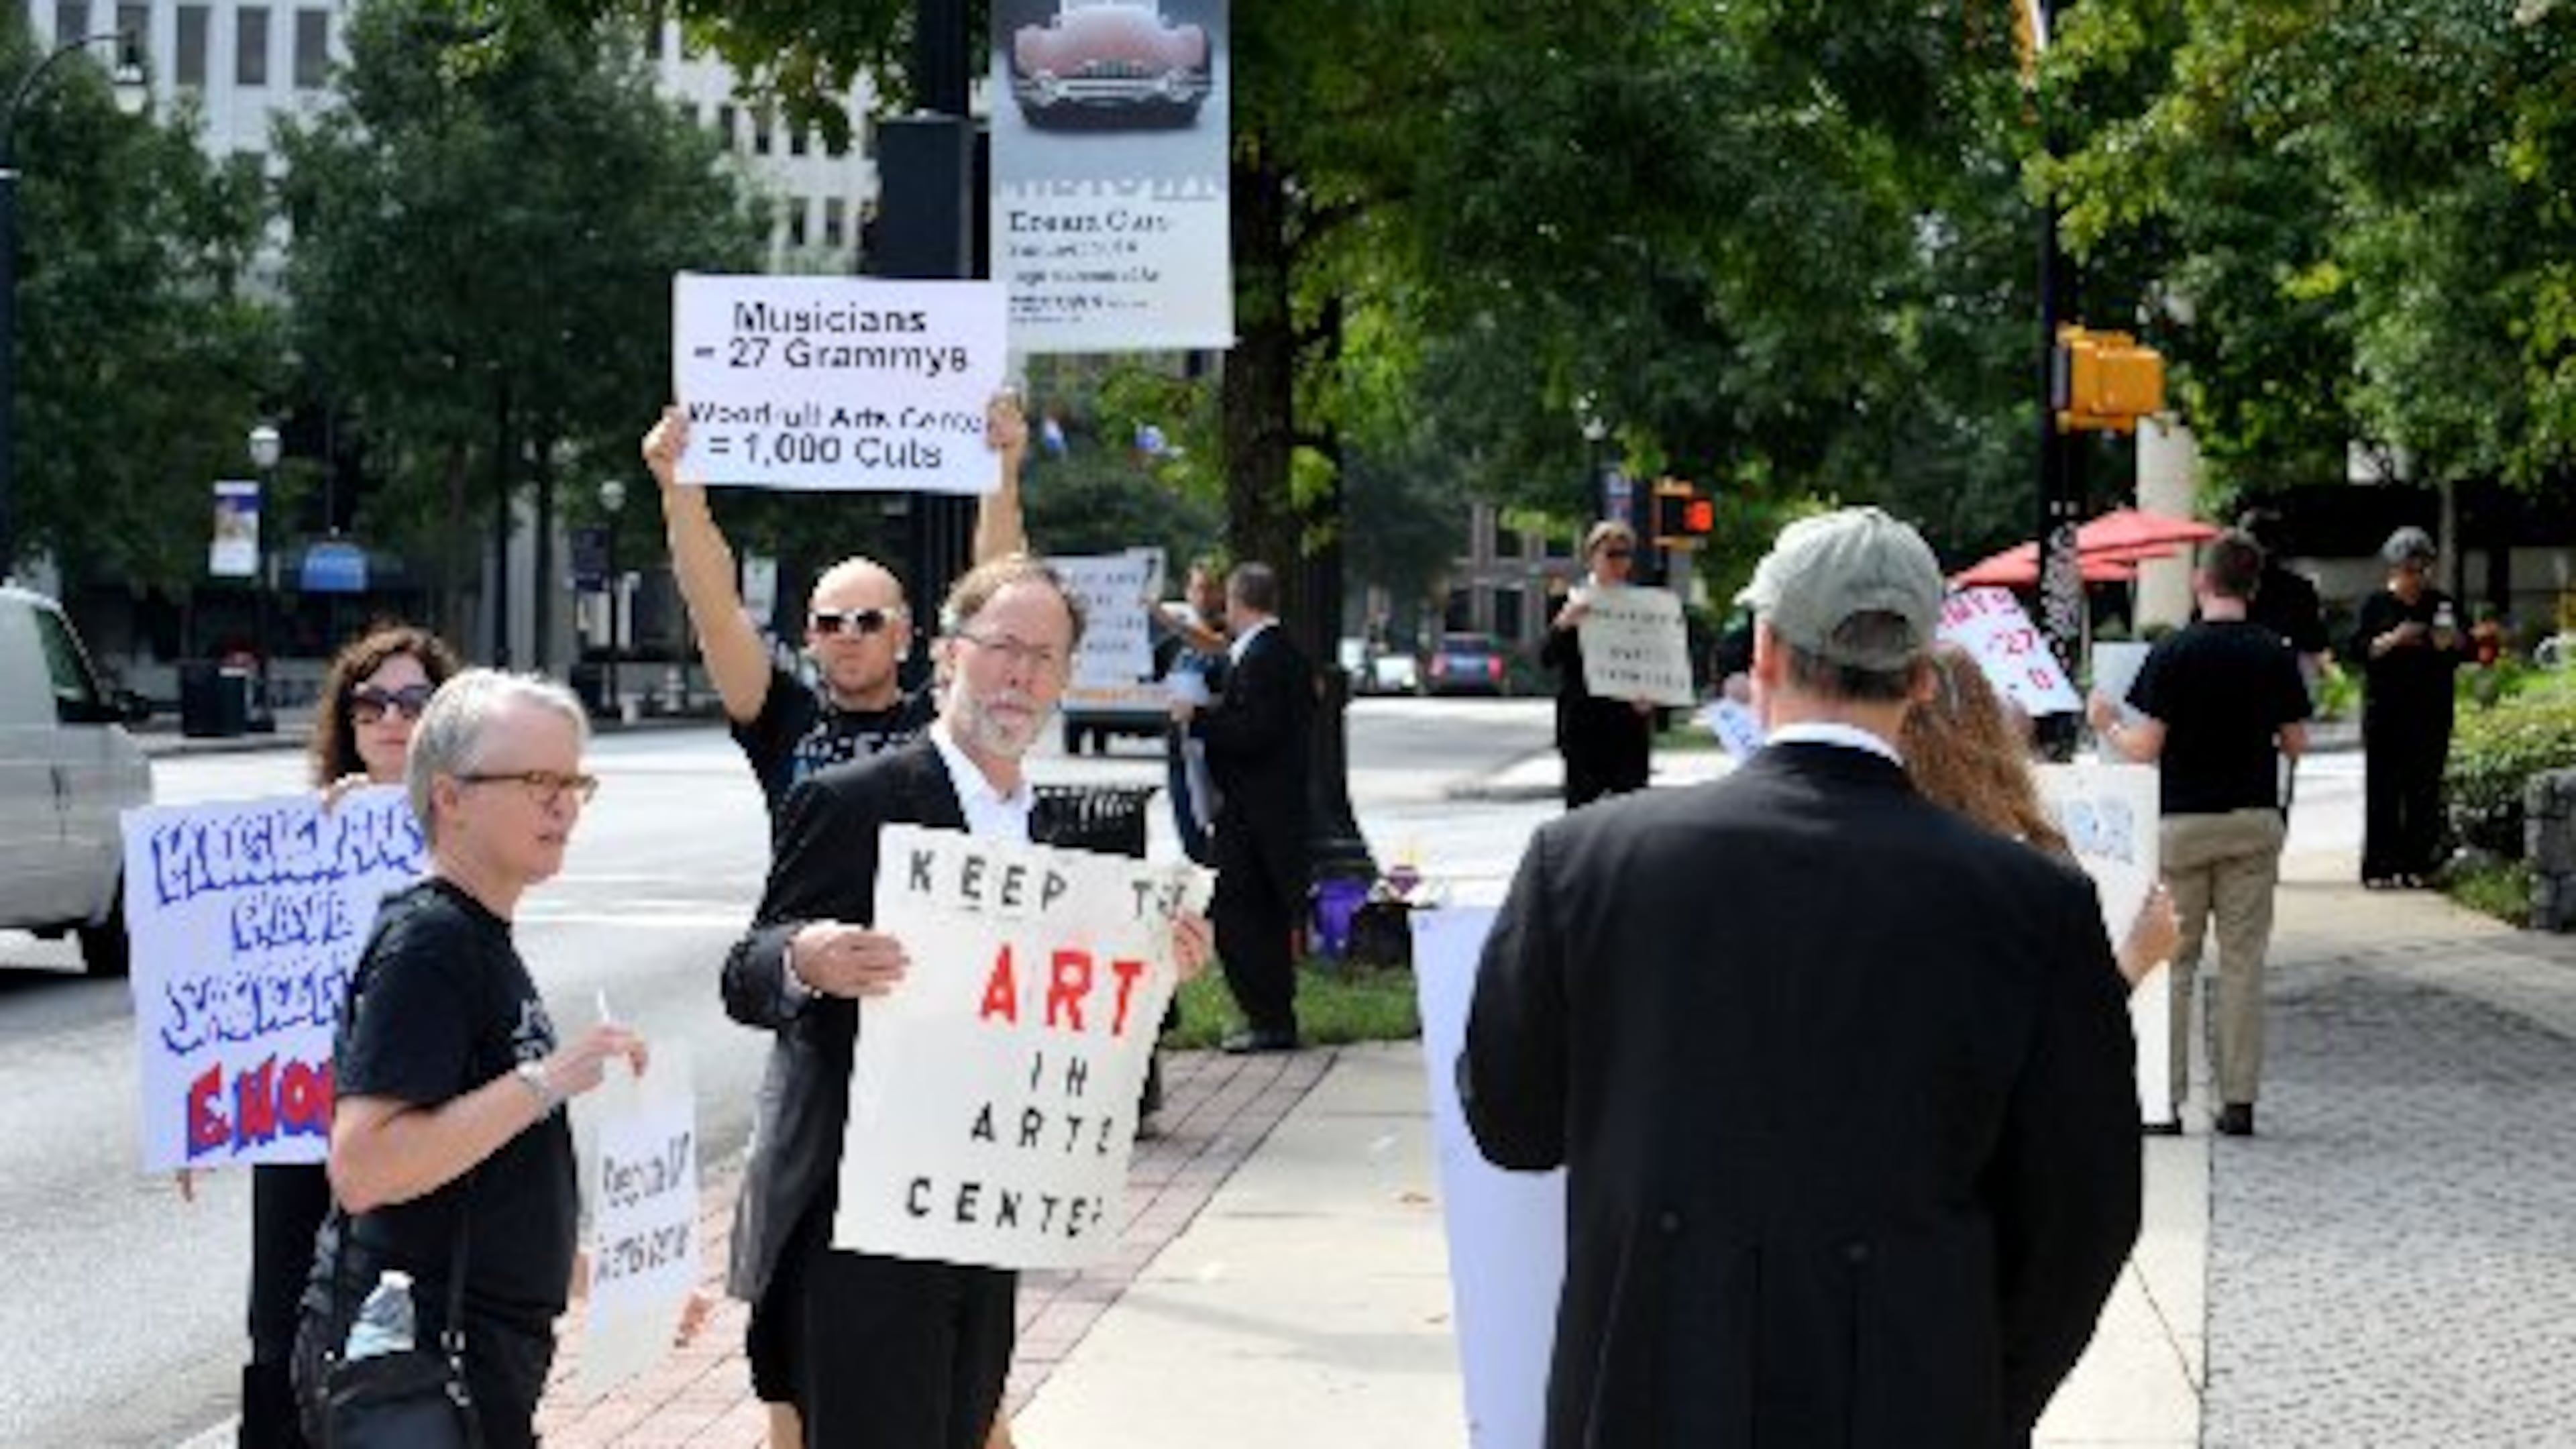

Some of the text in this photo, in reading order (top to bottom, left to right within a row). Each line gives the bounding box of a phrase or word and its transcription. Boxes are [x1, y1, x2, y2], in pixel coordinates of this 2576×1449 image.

[734, 301, 927, 333] Musicians
[729, 335, 771, 369] 27
[783, 336, 967, 378] Grammys
[708, 431, 942, 469] = 1,000 Cuts
[909, 848, 1068, 911] KEEP
[980, 942, 1148, 1036] ART
